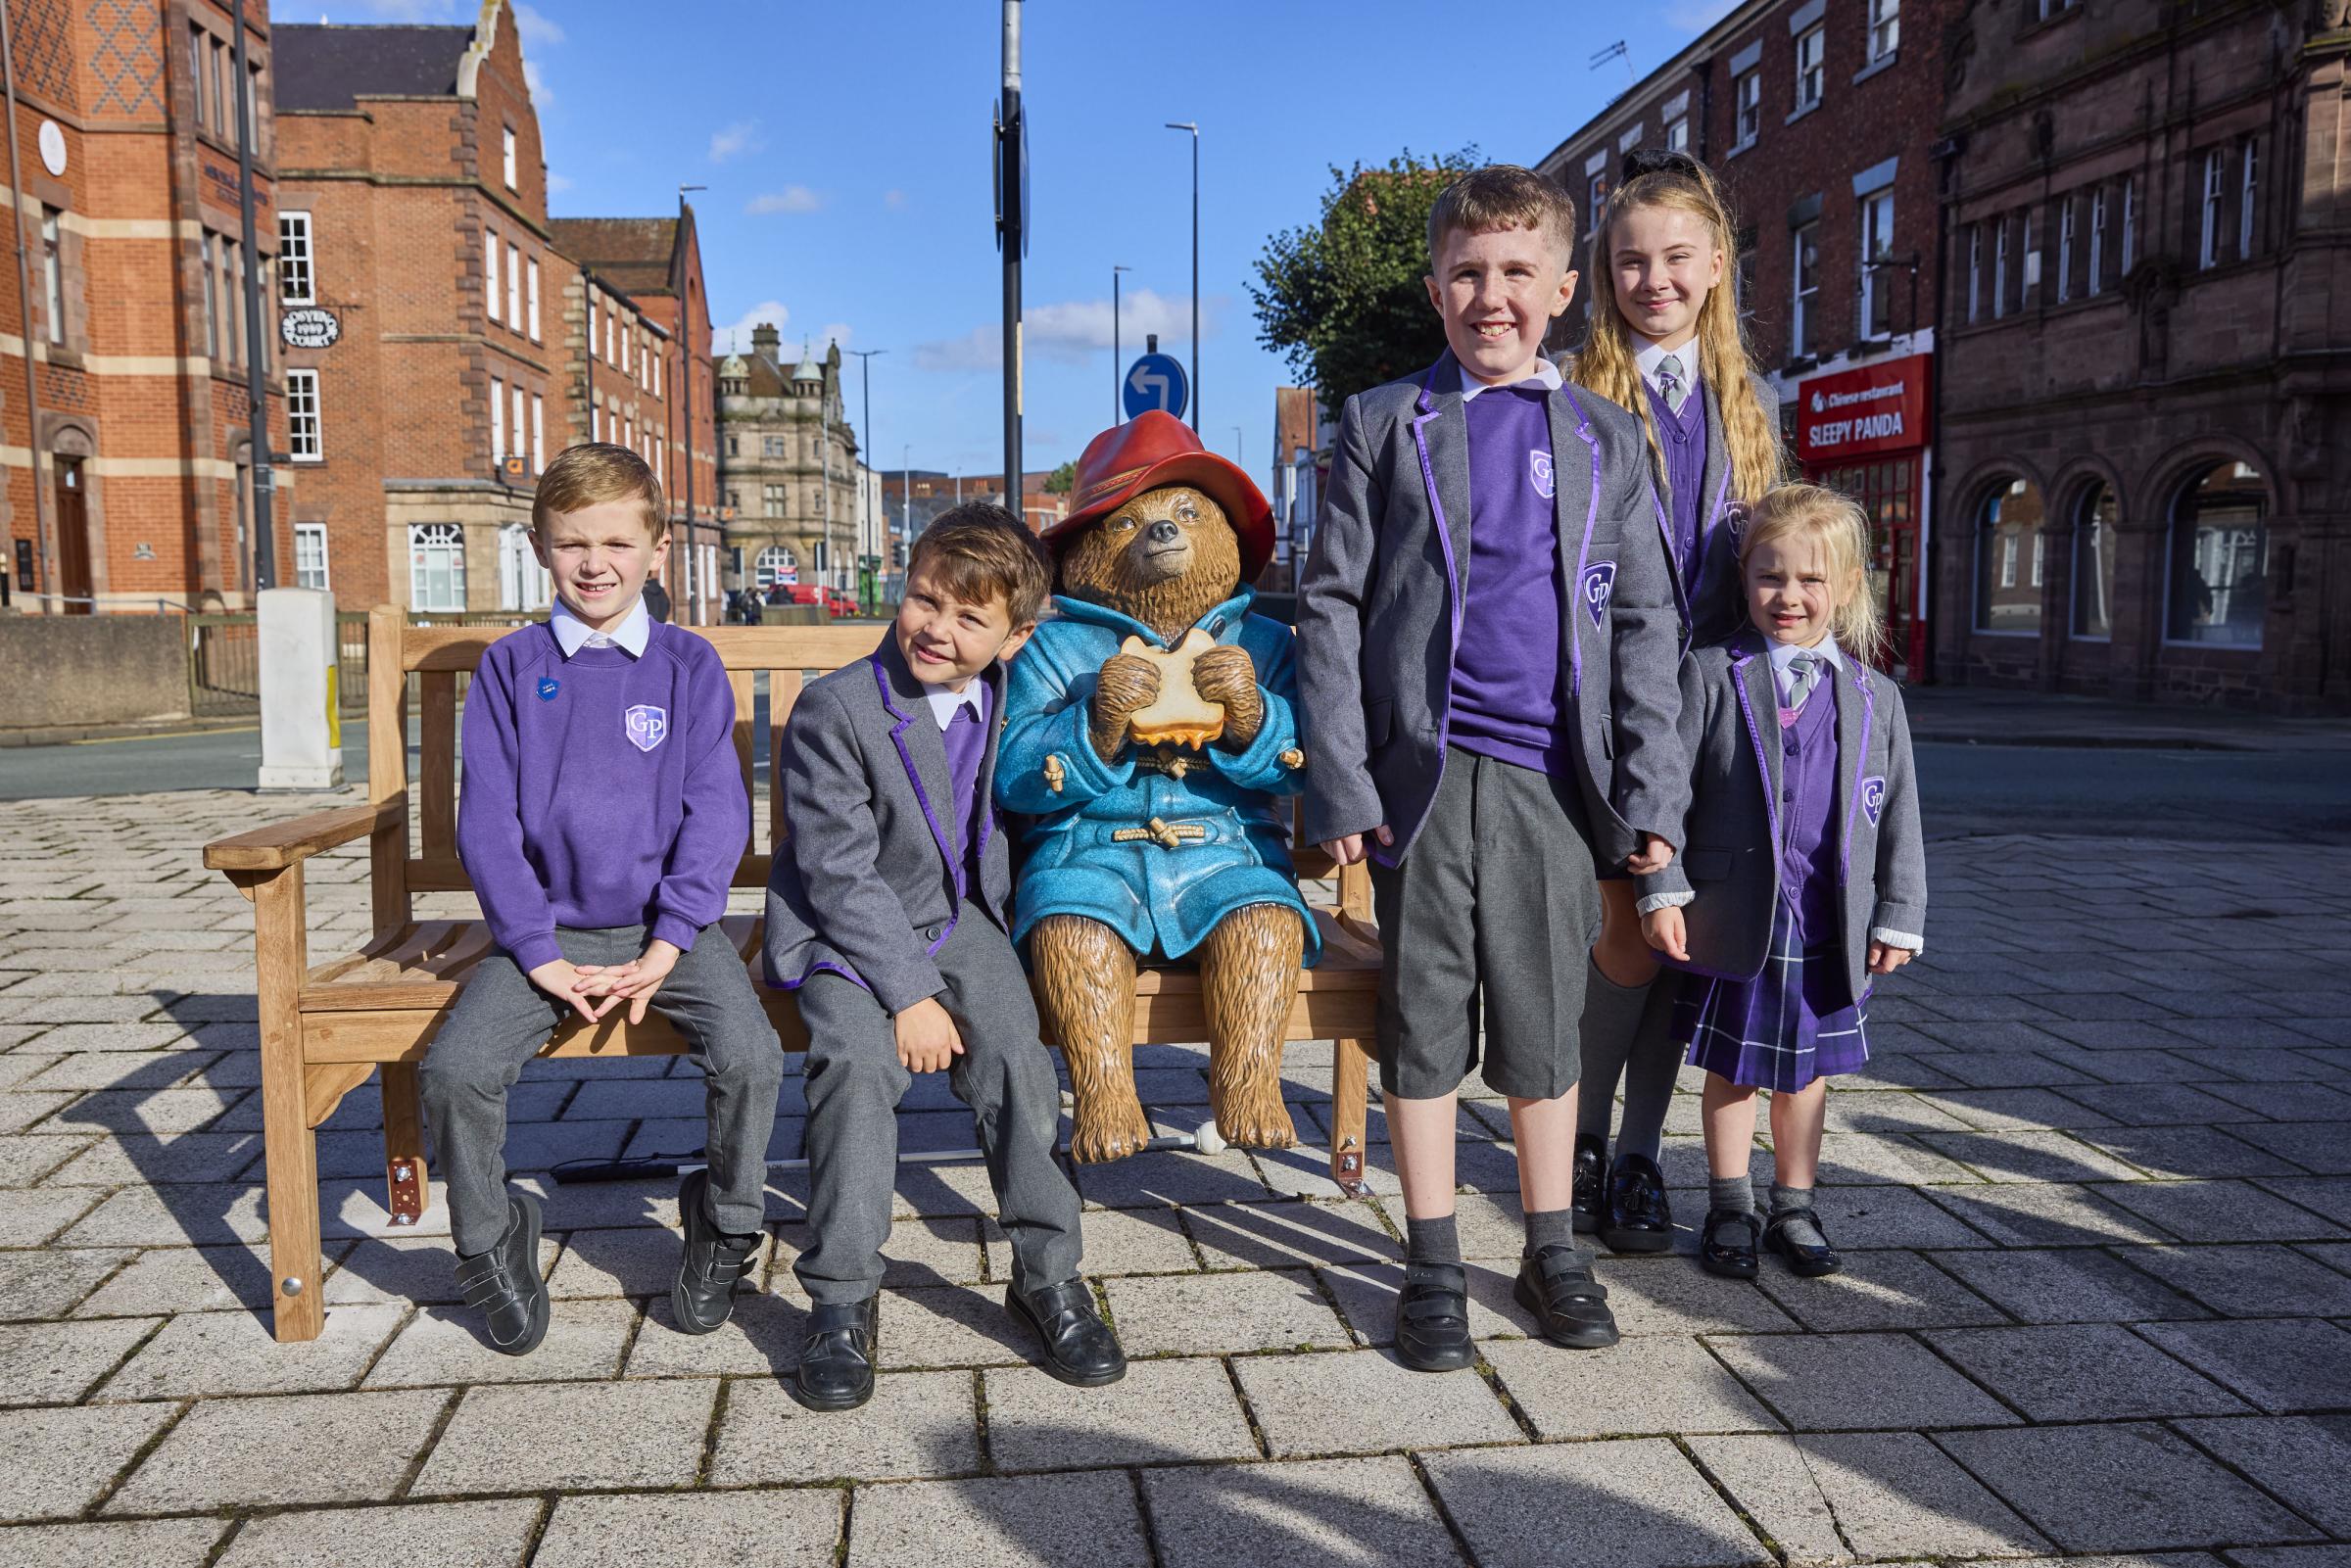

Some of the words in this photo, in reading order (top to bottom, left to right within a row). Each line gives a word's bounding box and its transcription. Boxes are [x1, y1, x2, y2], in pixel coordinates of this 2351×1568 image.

[285, 334, 330, 347] COURT
[1829, 392, 1859, 408] Chinese
[1809, 420, 1852, 448] SLEEPY
[1854, 411, 1903, 441] PANDA
[1586, 573, 1609, 612] GP
[630, 712, 663, 738] GP
[1865, 785, 1883, 814] GP
